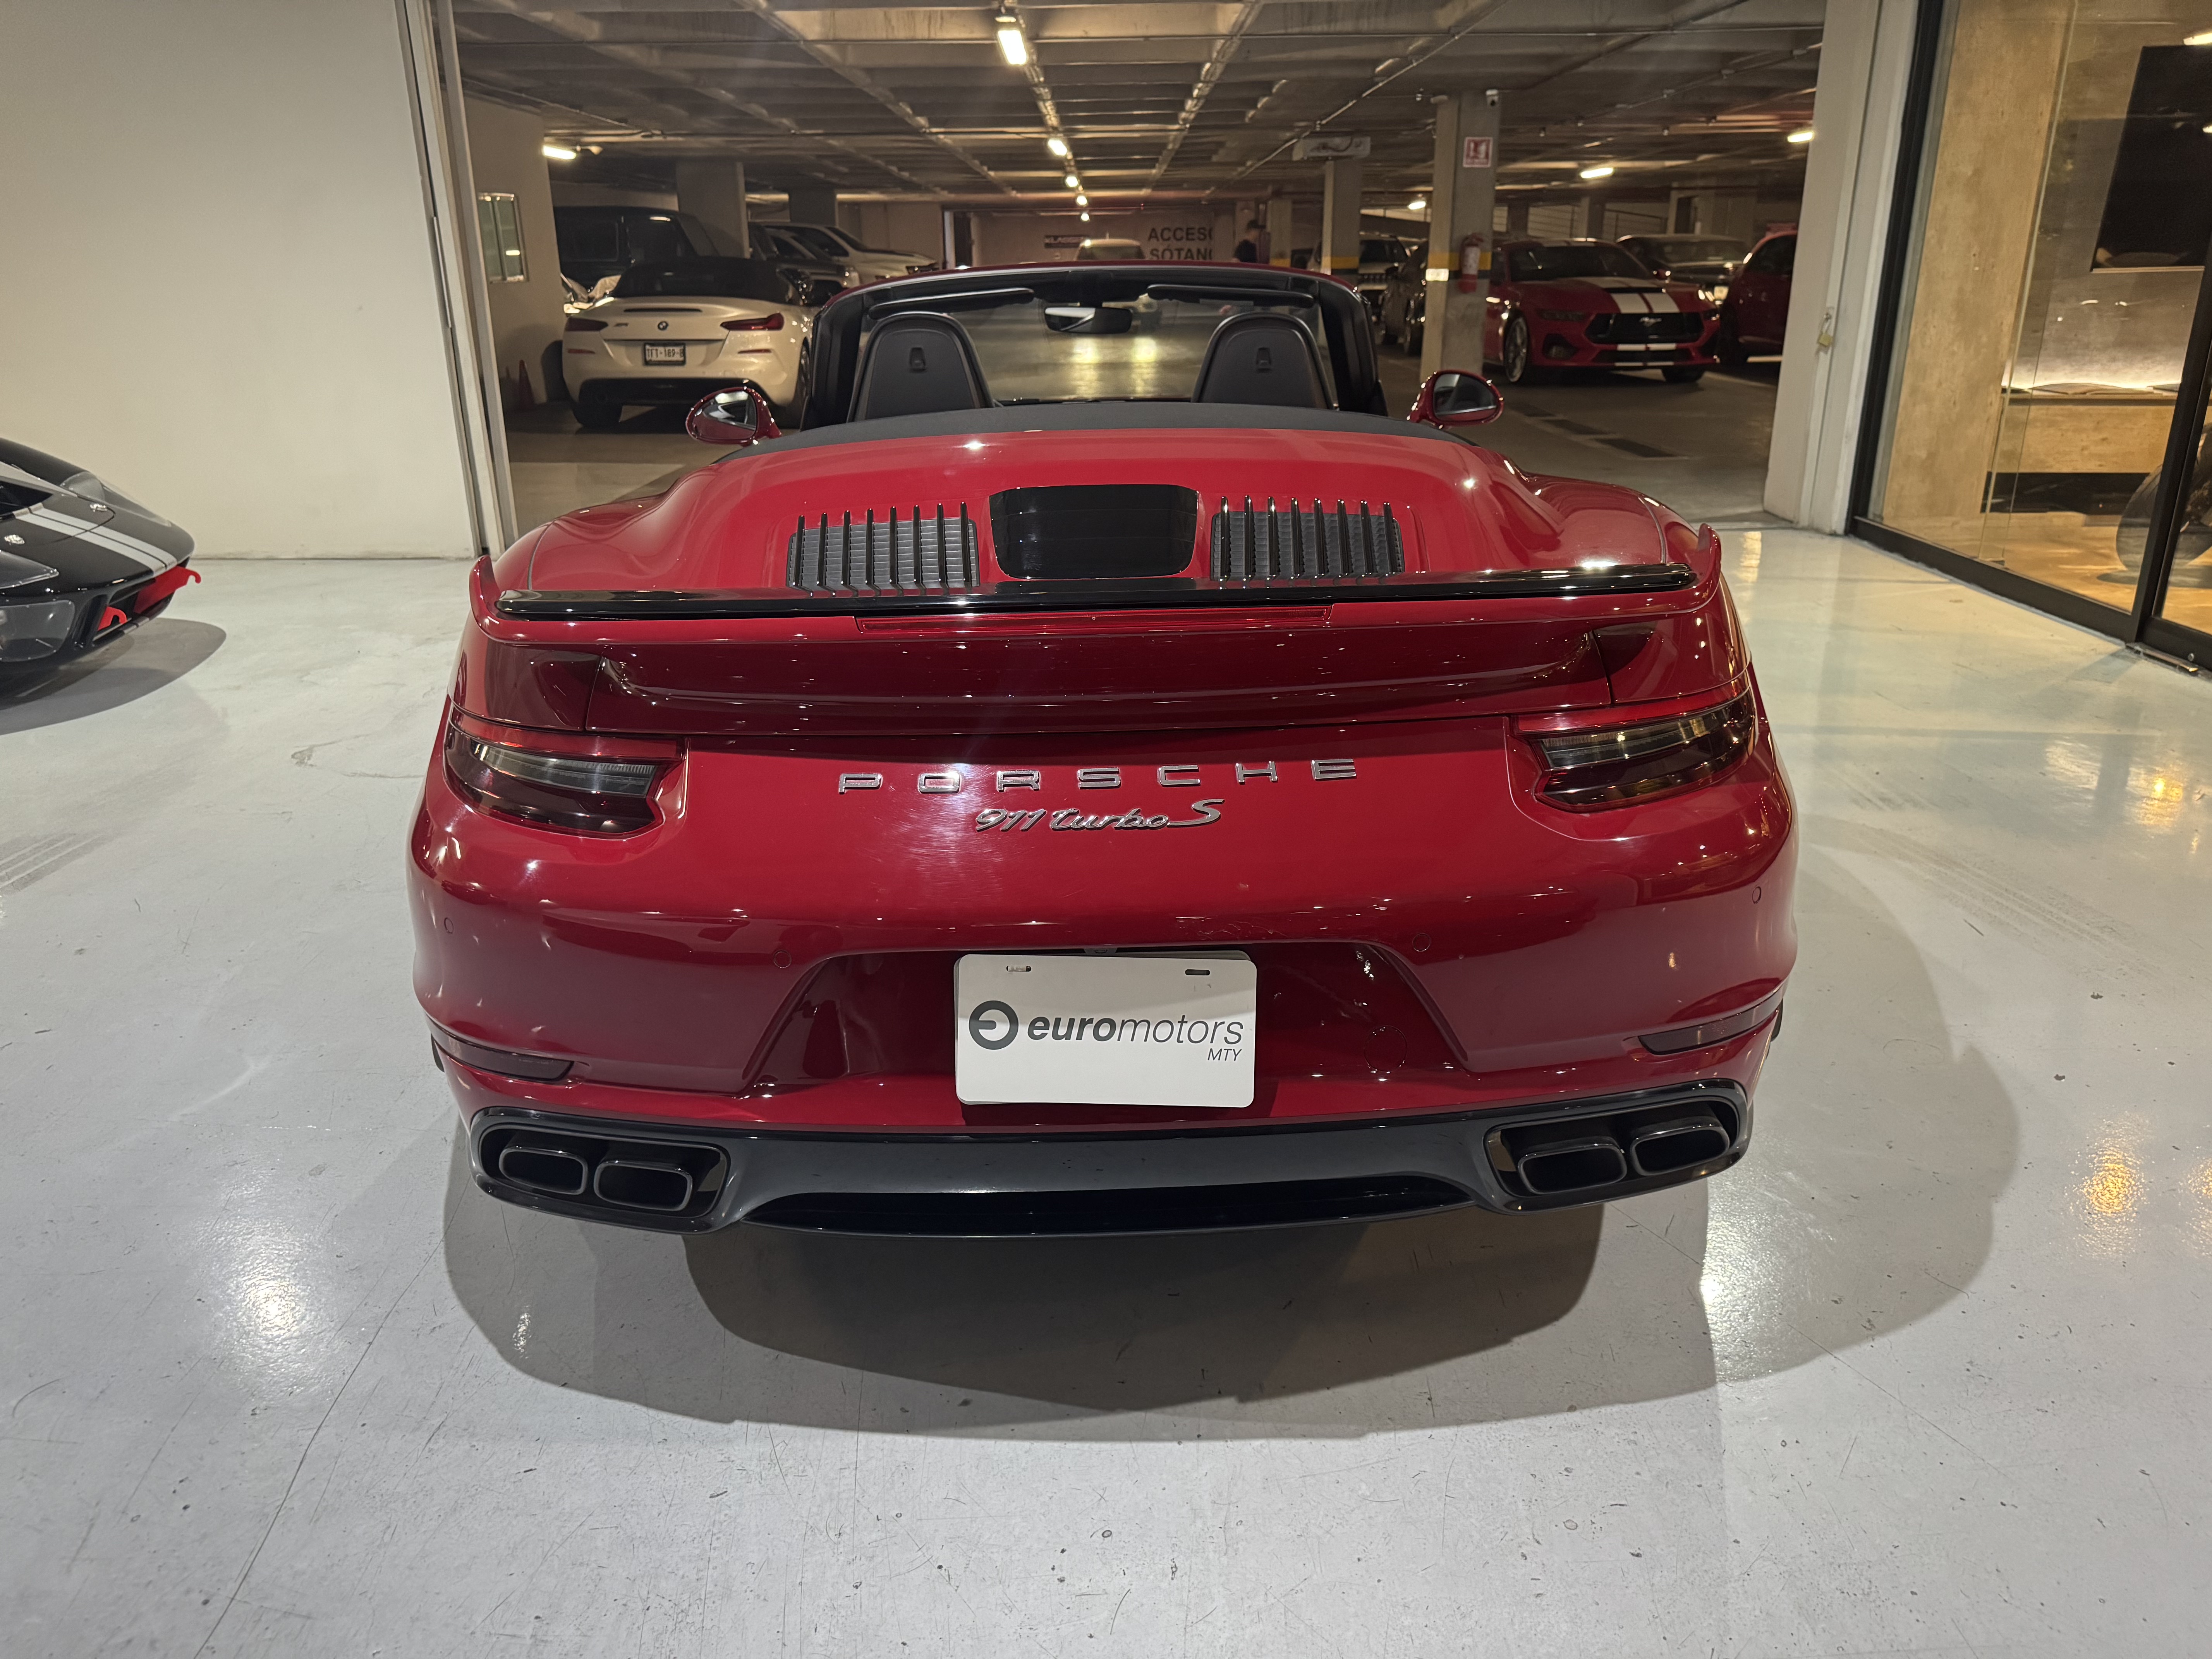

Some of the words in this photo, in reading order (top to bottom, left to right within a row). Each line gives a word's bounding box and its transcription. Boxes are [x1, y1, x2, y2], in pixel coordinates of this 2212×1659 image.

[1148, 227, 1213, 241] ACCES
[1149, 244, 1213, 260] SÓTAN
[838, 758, 1357, 794] PORSCHE
[975, 807, 1047, 831] 911
[1049, 807, 1169, 831] turbo
[1166, 799, 1225, 828] S
[1027, 1014, 1244, 1045] euromotors
[1207, 1048, 1242, 1061] MTY
